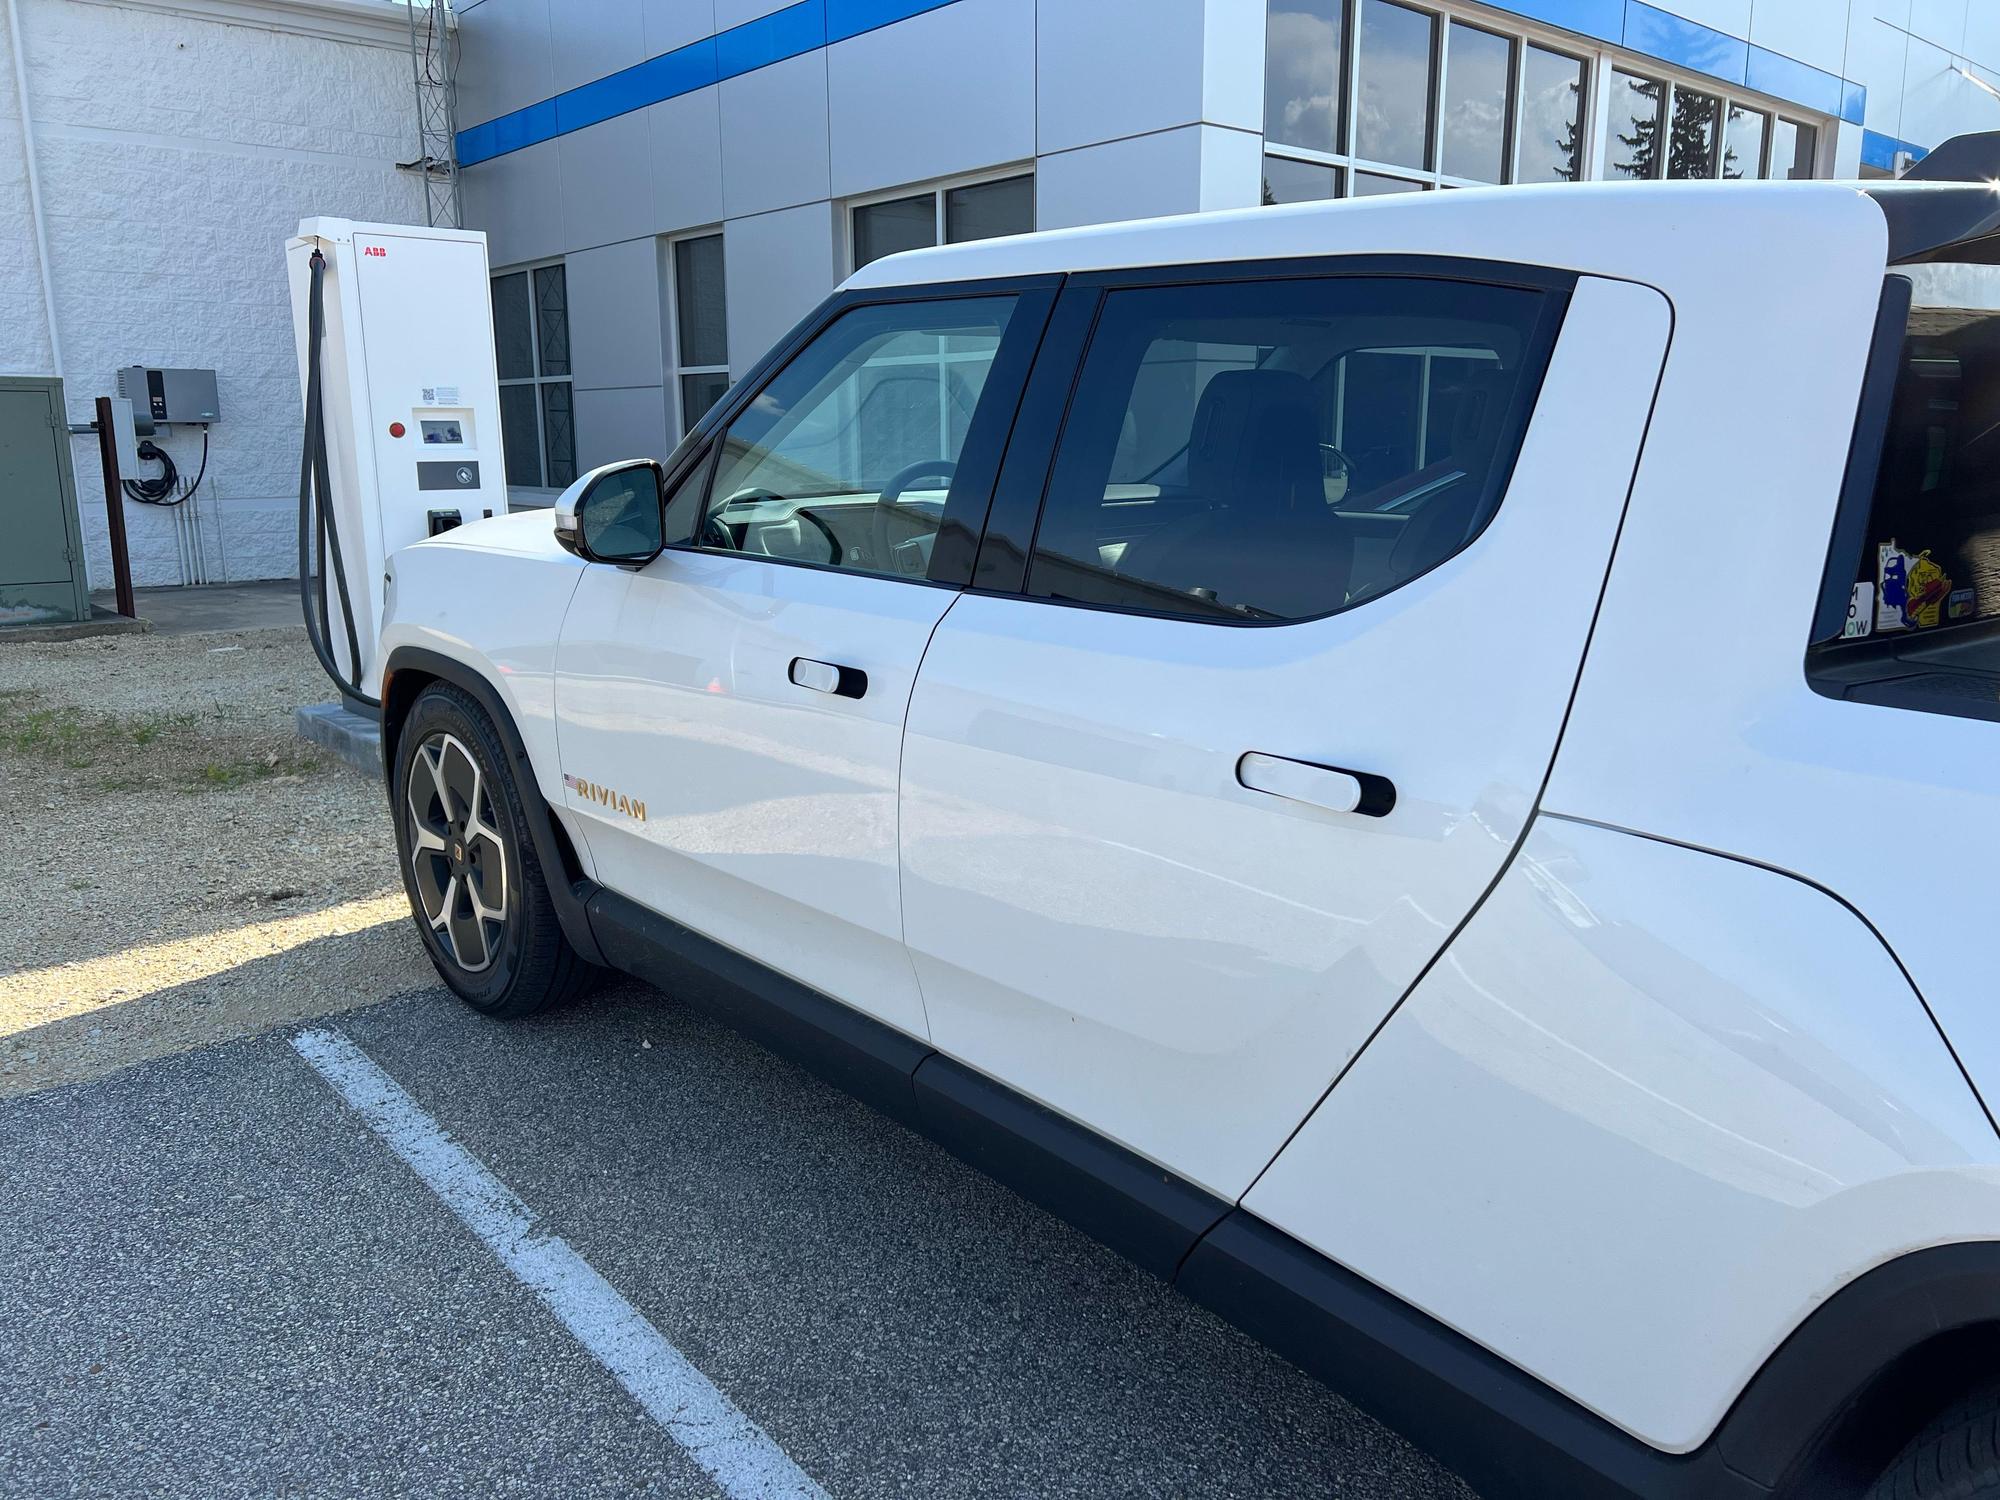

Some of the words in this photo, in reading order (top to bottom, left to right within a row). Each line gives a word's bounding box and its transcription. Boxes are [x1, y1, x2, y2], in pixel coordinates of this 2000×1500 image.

[365, 247, 386, 257] ABB
[1845, 620, 1868, 636] OW
[576, 778, 647, 822] RIVIAN
